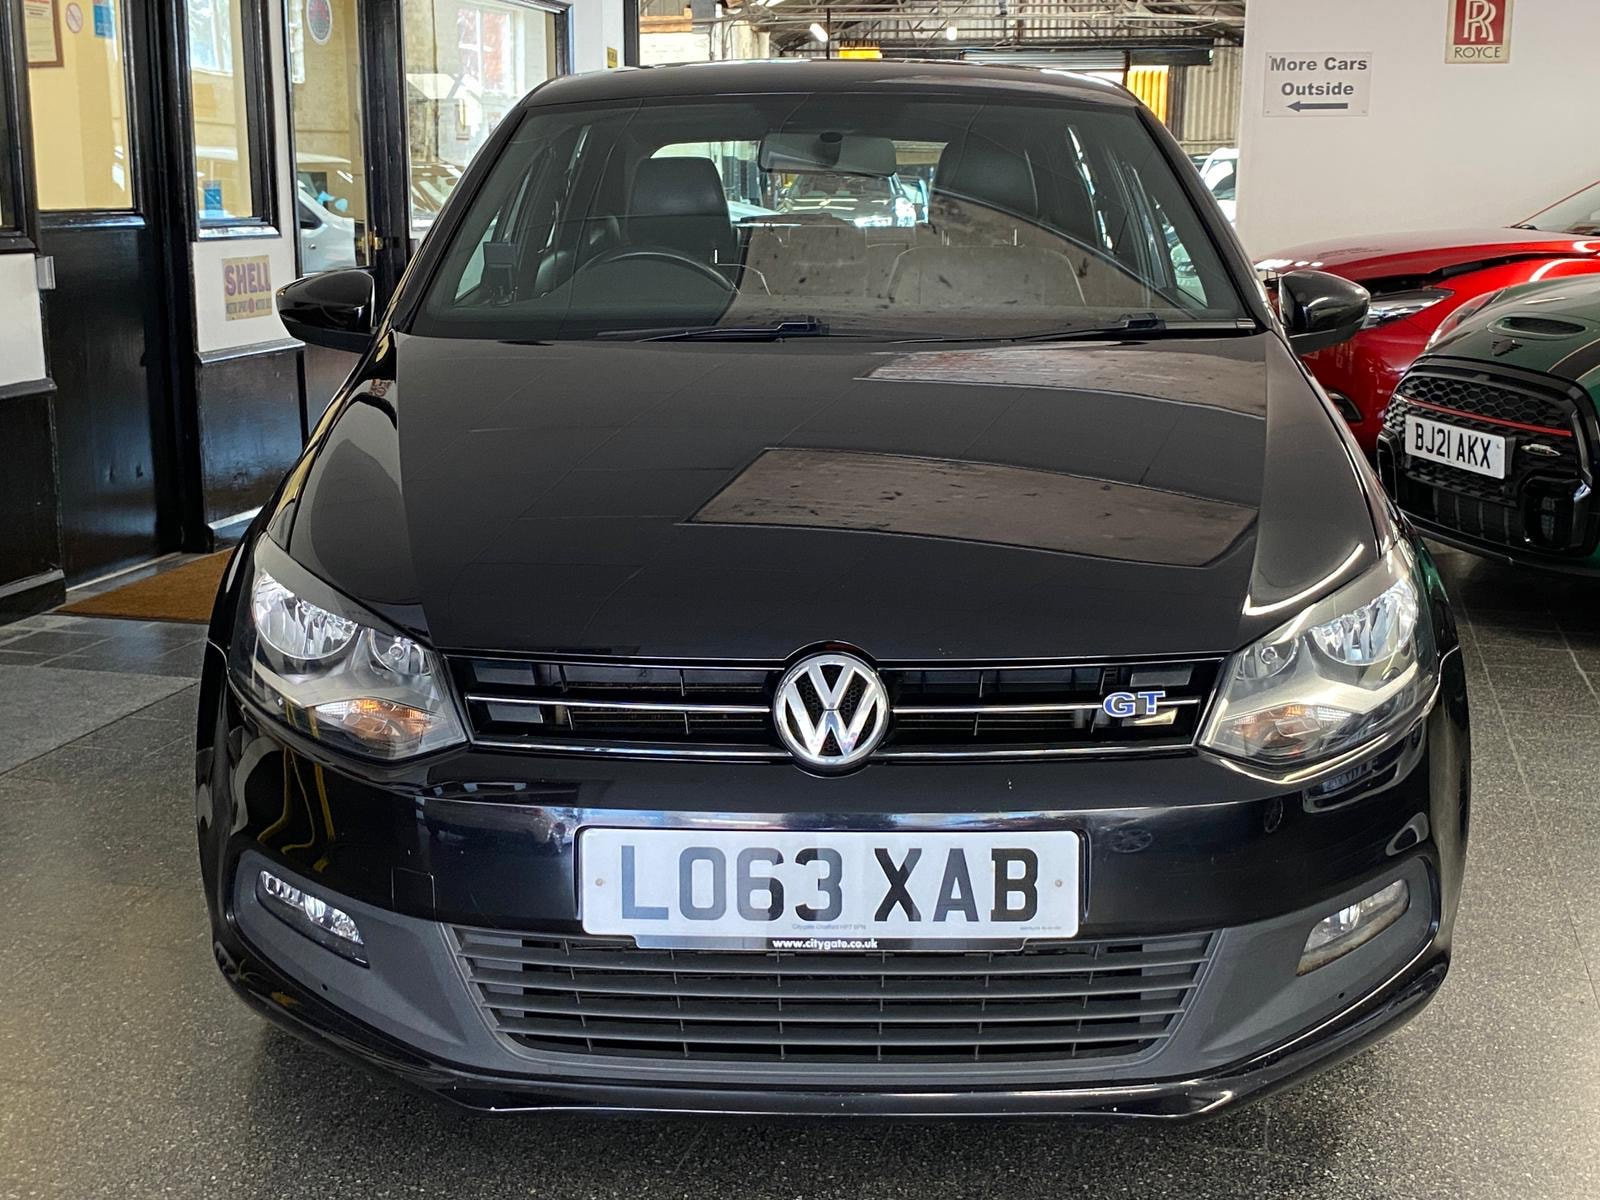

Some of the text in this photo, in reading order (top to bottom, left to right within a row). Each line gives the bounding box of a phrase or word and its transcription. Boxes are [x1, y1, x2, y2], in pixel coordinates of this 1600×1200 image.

[1454, 46, 1501, 59] ROYCE
[1270, 56, 1368, 72] More Cars
[1281, 82, 1355, 96] Outside
[224, 262, 271, 297] SHELL
[1415, 422, 1491, 470] BJ21 AKX
[1102, 690, 1166, 718] GT
[621, 845, 1039, 923] LO63 XAB
[772, 938, 878, 950] www.citygate.co.uk
